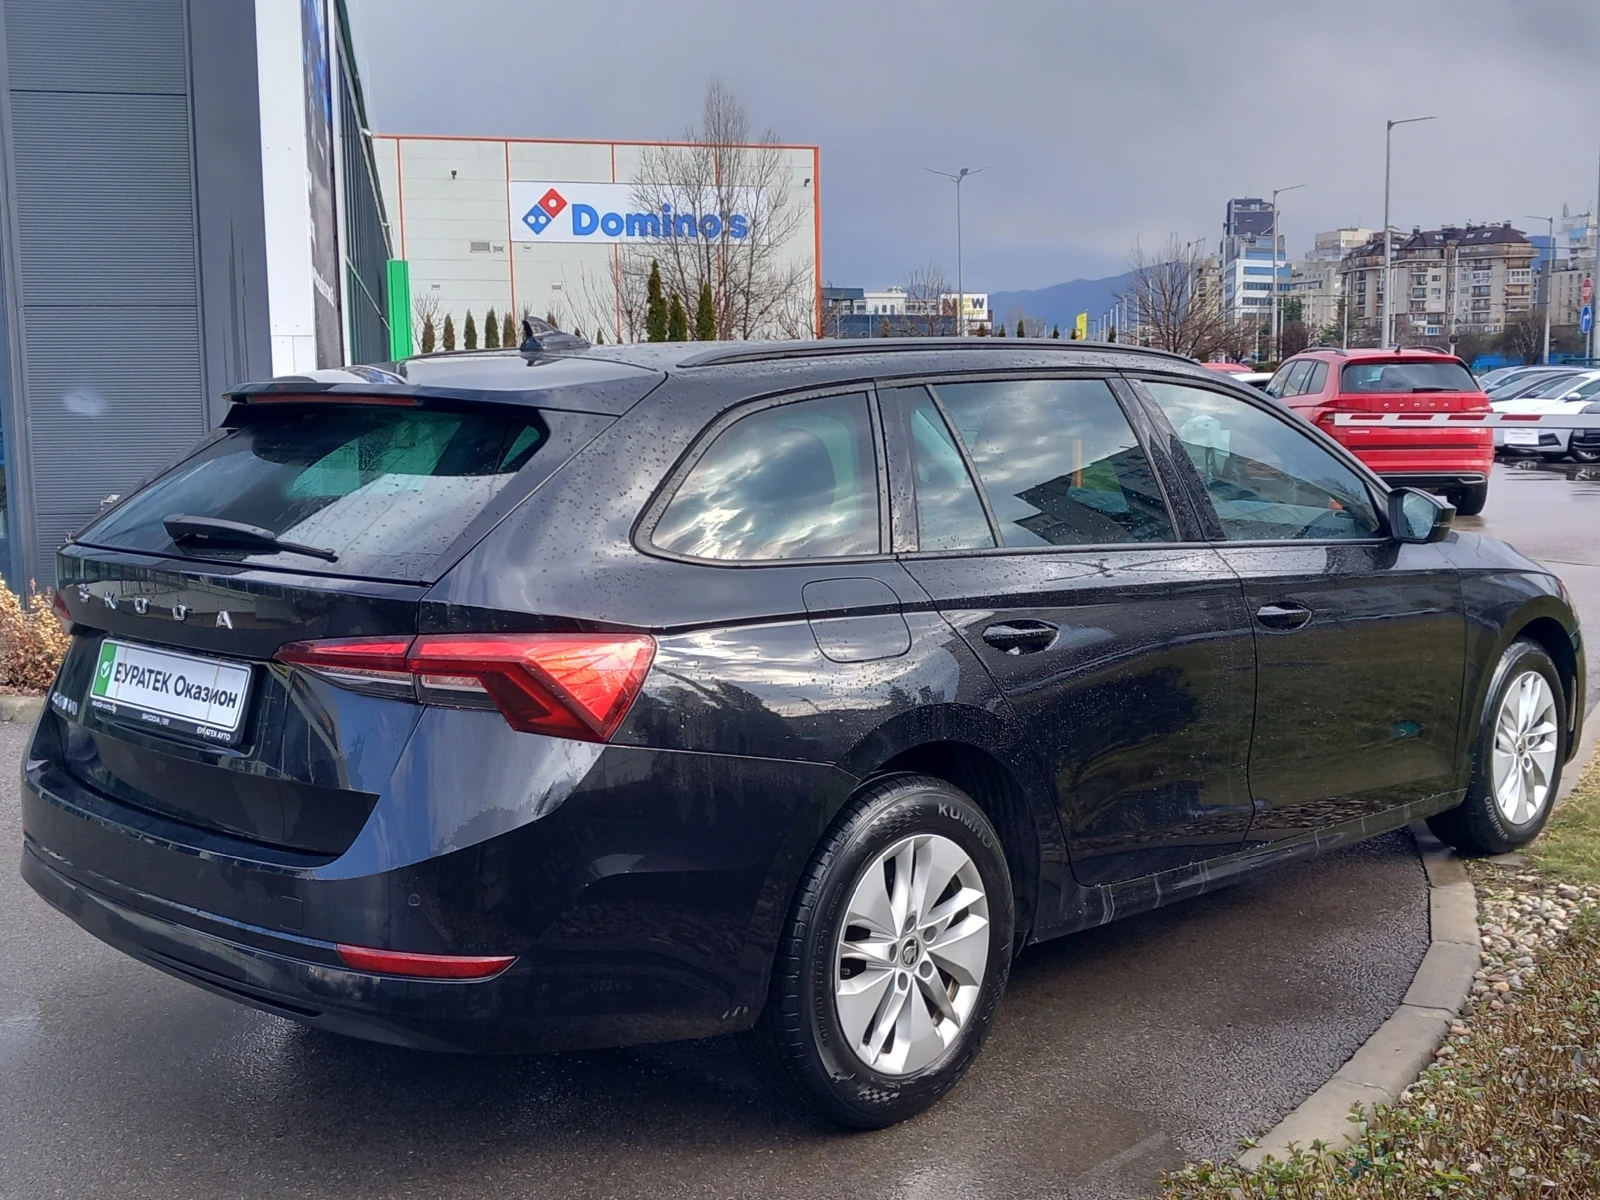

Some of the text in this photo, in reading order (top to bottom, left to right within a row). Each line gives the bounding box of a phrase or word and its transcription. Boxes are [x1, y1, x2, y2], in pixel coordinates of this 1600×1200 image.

[571, 203, 748, 239] Domino's
[113, 661, 239, 709] ЕУРАТЕК Оказион
